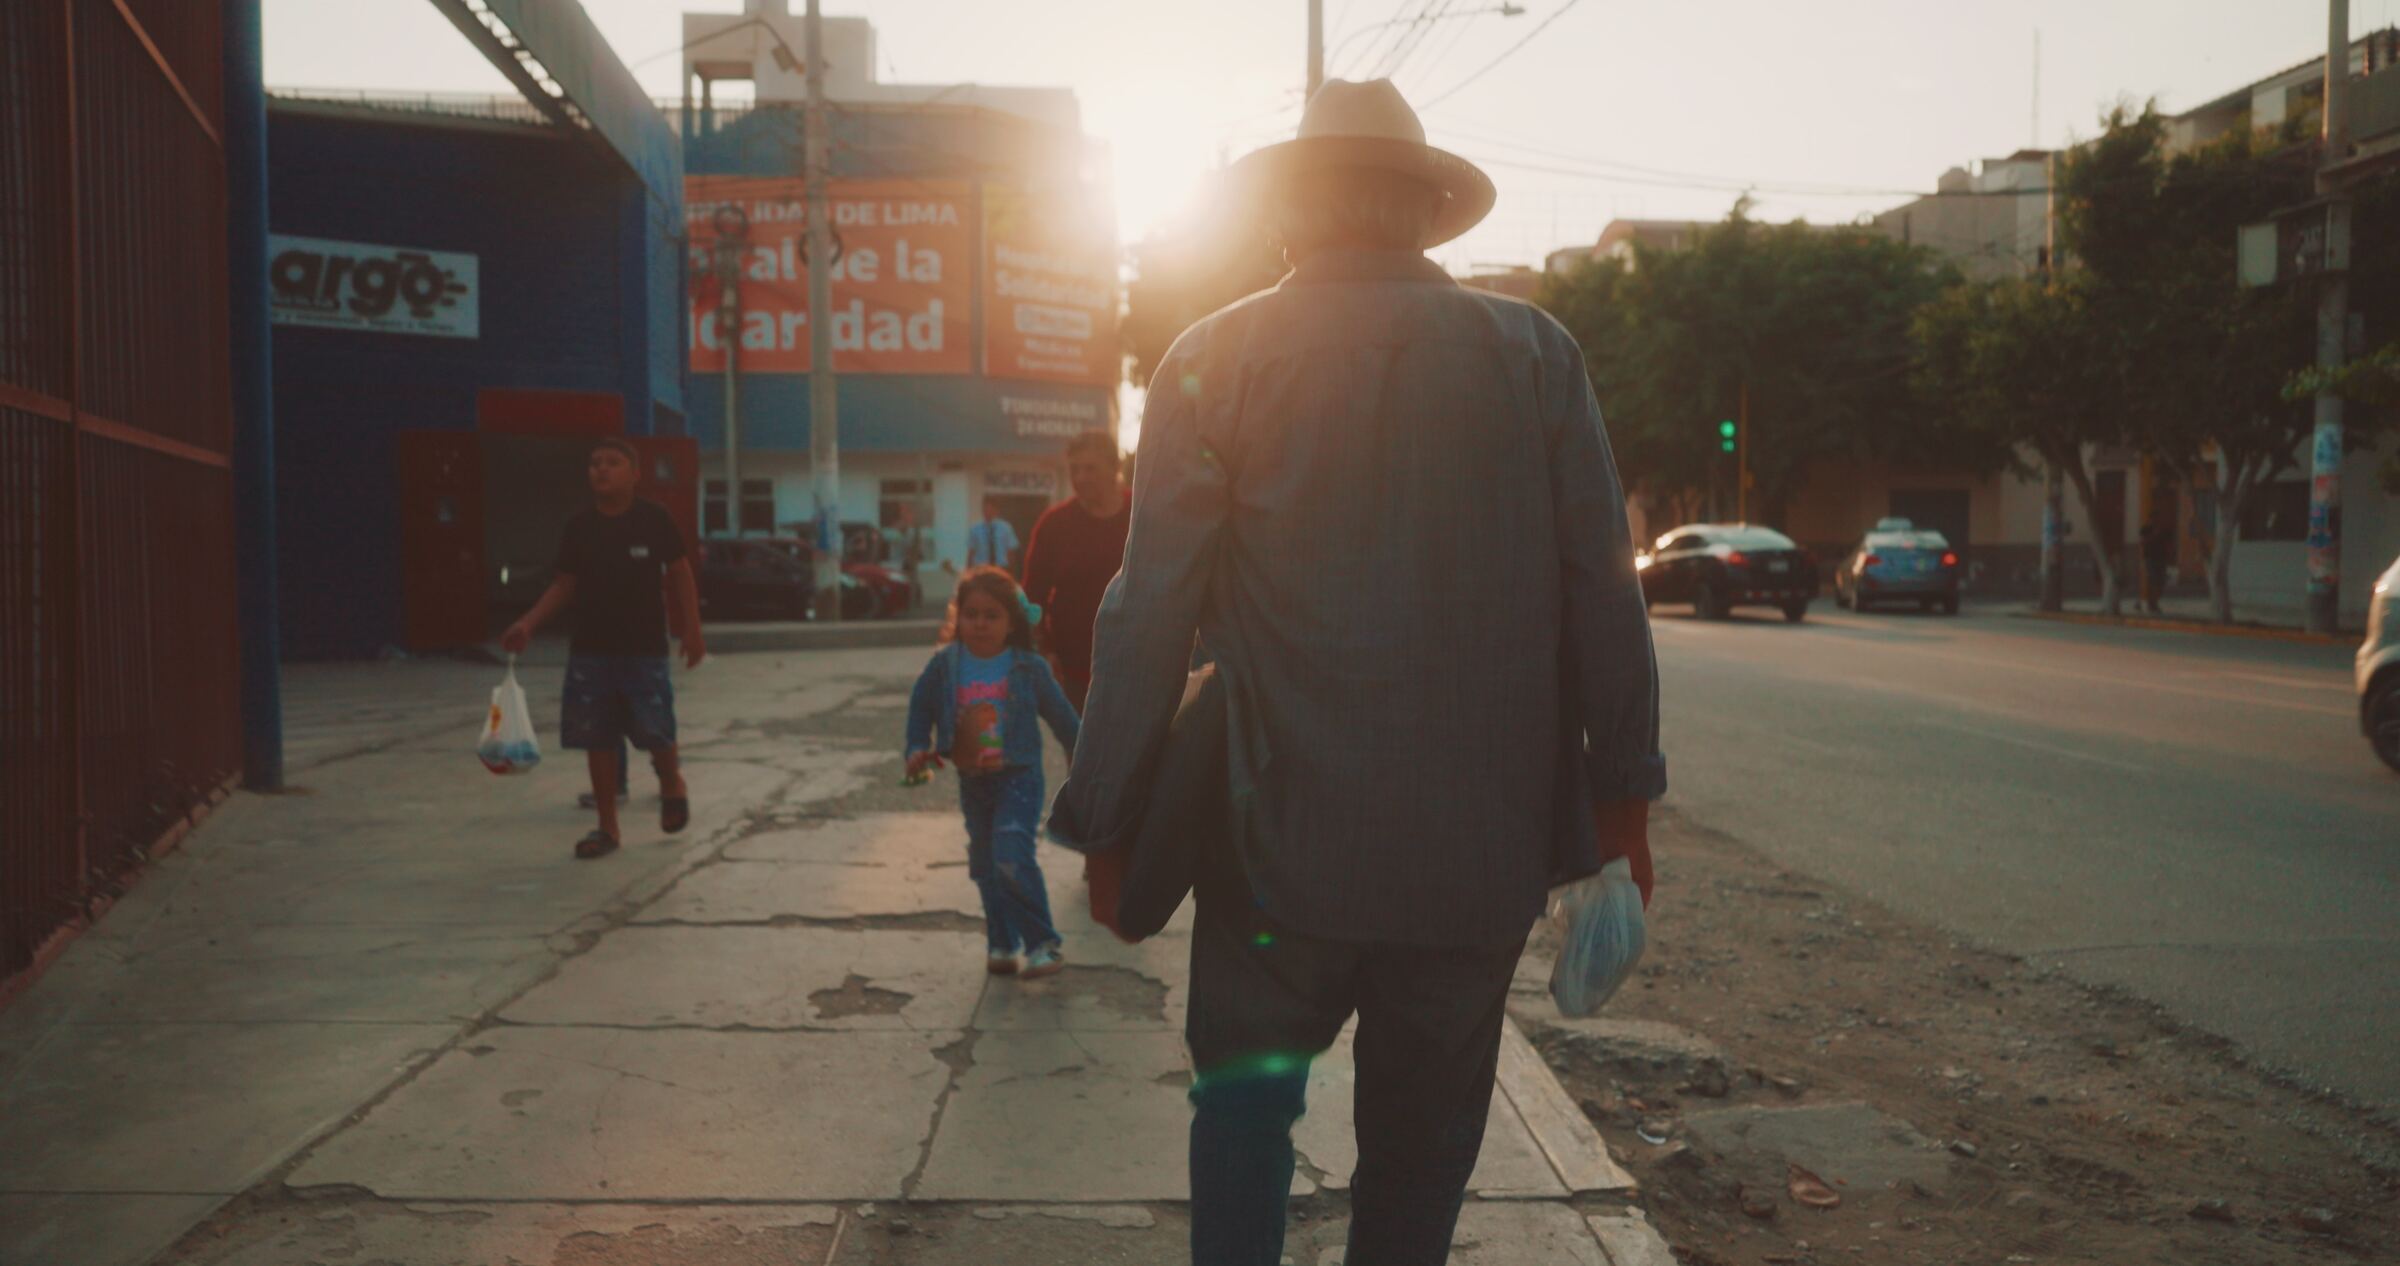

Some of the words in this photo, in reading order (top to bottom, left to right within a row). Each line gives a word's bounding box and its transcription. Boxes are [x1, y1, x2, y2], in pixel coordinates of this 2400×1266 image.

[834, 201, 874, 224] DE
[882, 203, 958, 226] LIMA
[894, 239, 942, 283] la
